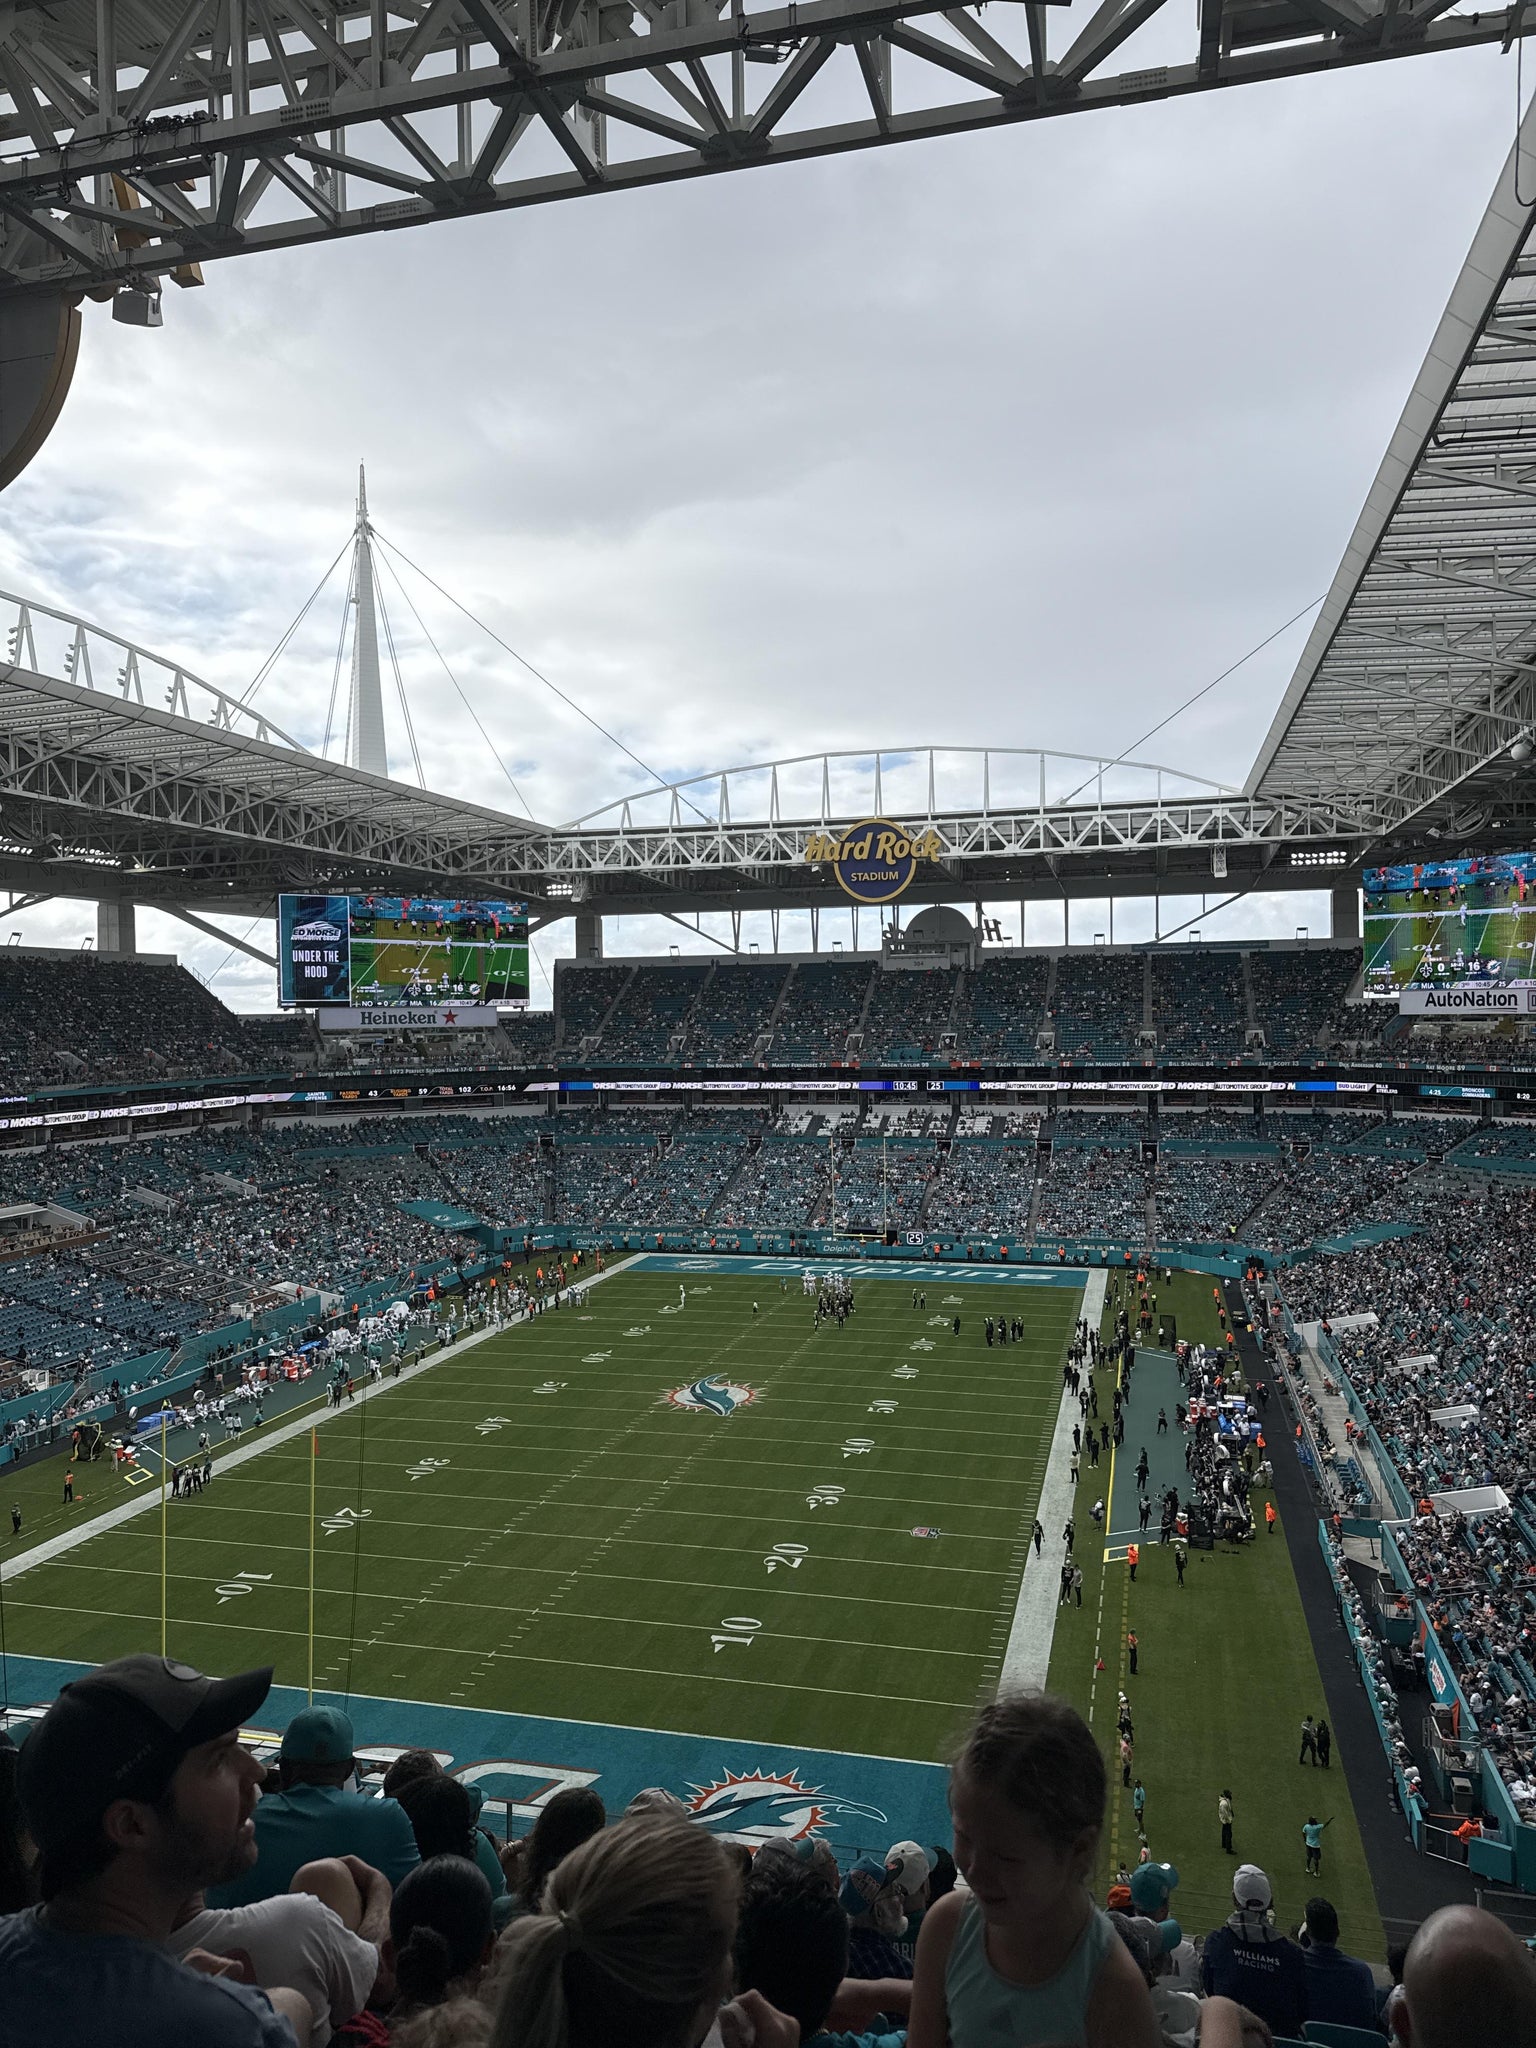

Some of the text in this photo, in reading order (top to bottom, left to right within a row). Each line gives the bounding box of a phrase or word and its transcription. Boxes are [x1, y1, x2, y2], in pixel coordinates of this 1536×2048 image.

[804, 829, 941, 865] Hard Rock
[850, 871, 899, 882] STADIUM
[293, 928, 340, 937] ED MORSE
[292, 950, 339, 962] UNDER THE
[305, 965, 328, 978] HOOD
[1468, 962, 1480, 972] 16
[453, 984, 464, 992] 16
[1425, 991, 1518, 1007] AutoNation
[360, 1010, 437, 1026] Heineken
[497, 1084, 516, 1092] 16:56
[672, 1082, 702, 1090] MORSE
[760, 1082, 792, 1090] MORSE
[894, 1082, 916, 1090] 10:45
[930, 1082, 941, 1090] 25
[1058, 1082, 1071, 1090] ED
[1072, 1082, 1108, 1090] MORSE
[1161, 1082, 1176, 1090] ED
[1177, 1082, 1214, 1090] MORSE
[10, 1116, 43, 1128] MORSE
[100, 1108, 129, 1118] MORSE
[178, 1100, 202, 1110] MORSE
[909, 1234, 922, 1244] 25
[867, 1400, 900, 1414] 50
[475, 1416, 512, 1432] 40
[840, 1438, 875, 1455] 40
[405, 1457, 451, 1476] 30
[806, 1485, 846, 1505] 30
[321, 1507, 373, 1529] 20
[763, 1543, 809, 1569] 20
[215, 1570, 274, 1596] 10
[711, 1616, 763, 1647] 10
[1233, 1948, 1281, 1966] WILLIAMS
[1237, 1957, 1275, 1973] RACING
